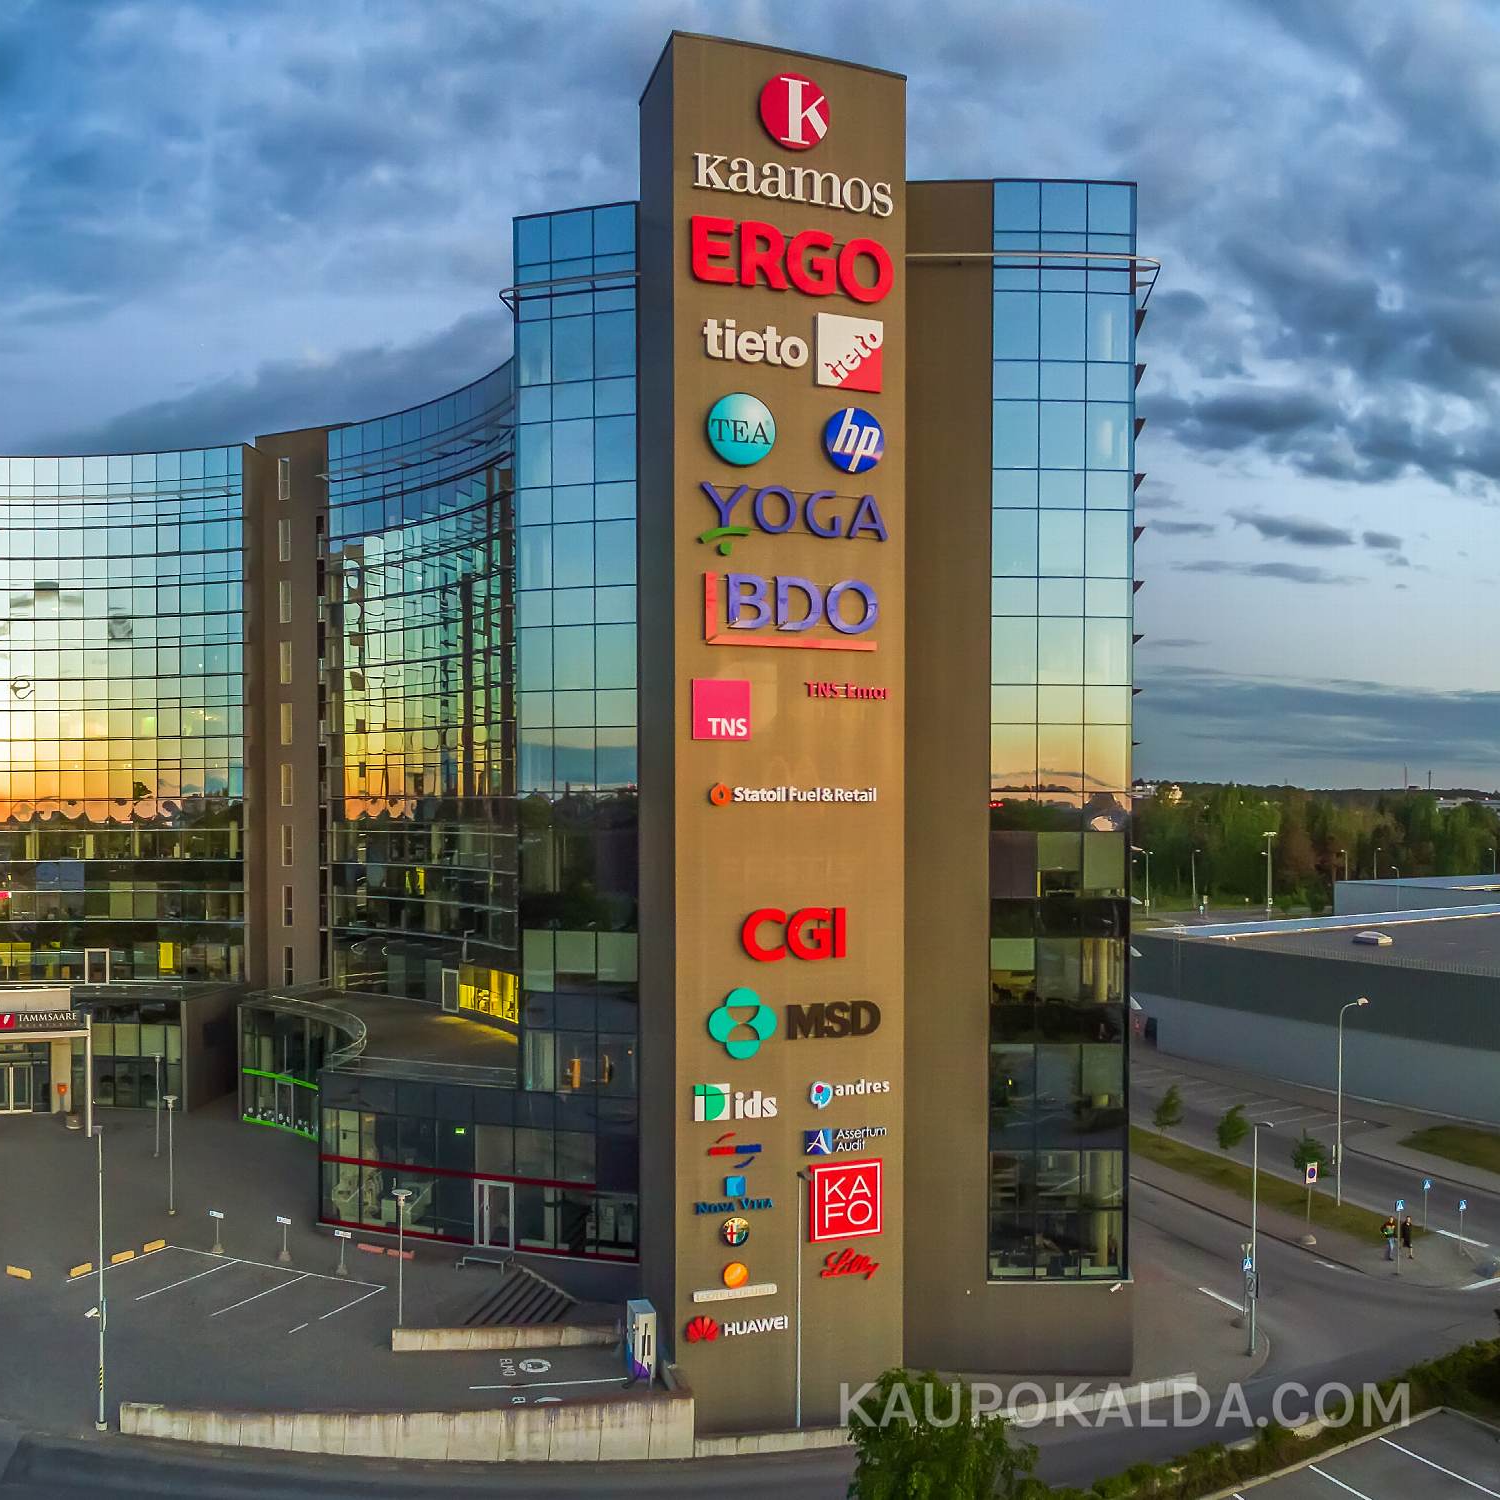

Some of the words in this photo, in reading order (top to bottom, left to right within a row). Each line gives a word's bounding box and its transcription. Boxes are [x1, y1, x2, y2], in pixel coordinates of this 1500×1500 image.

[691, 215, 894, 304] ERGO
[703, 318, 809, 369] tieto
[824, 327, 883, 385] tieto
[711, 418, 771, 445] TEA
[832, 407, 880, 472] hp
[701, 481, 888, 542] YOGA
[726, 572, 879, 634] BDO
[806, 681, 840, 698] TNS
[708, 717, 748, 737] TNS
[734, 786, 786, 802] Statoil
[741, 907, 846, 962] CGI
[18, 1012, 77, 1022] TAMMSAARE
[786, 1000, 881, 1040] MSD
[835, 1078, 890, 1097] andres
[735, 1090, 778, 1120] ids
[836, 1126, 887, 1140] Assertum
[836, 1139, 865, 1152] Audit
[824, 1175, 872, 1202] KA
[824, 1200, 873, 1229] FO
[820, 1247, 880, 1280] Lilly
[724, 1315, 789, 1337] HUAWEI
